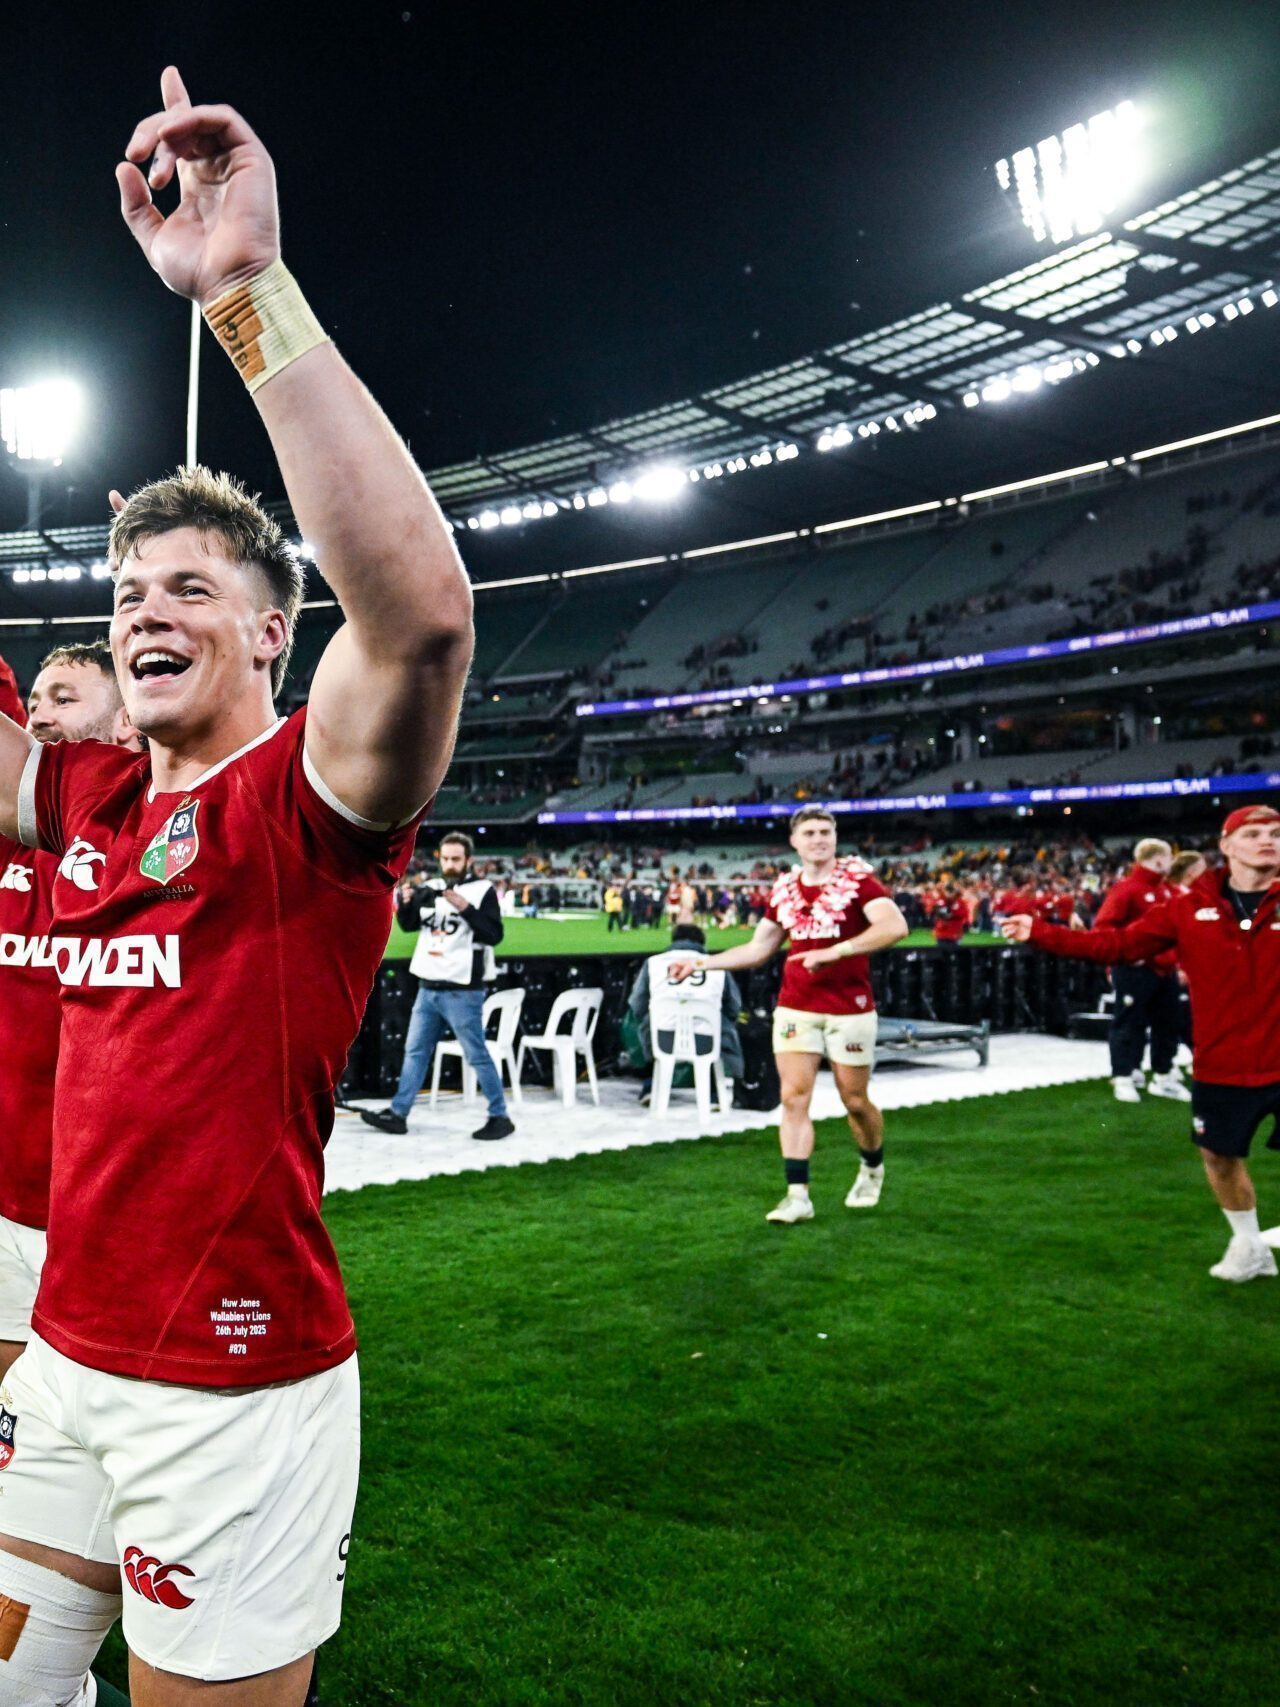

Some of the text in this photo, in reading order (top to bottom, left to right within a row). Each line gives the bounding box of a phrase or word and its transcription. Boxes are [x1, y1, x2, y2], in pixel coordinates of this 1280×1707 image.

[1172, 778, 1210, 795] TEAM
[143, 884, 195, 898] AUSTRALIA
[51, 934, 181, 987] OWDEN
[222, 1298, 260, 1307] Huw Jones
[210, 1311, 271, 1321] Wallabies v Lions
[215, 1325, 266, 1337] 26th July 2025
[228, 1344, 246, 1354] #878
